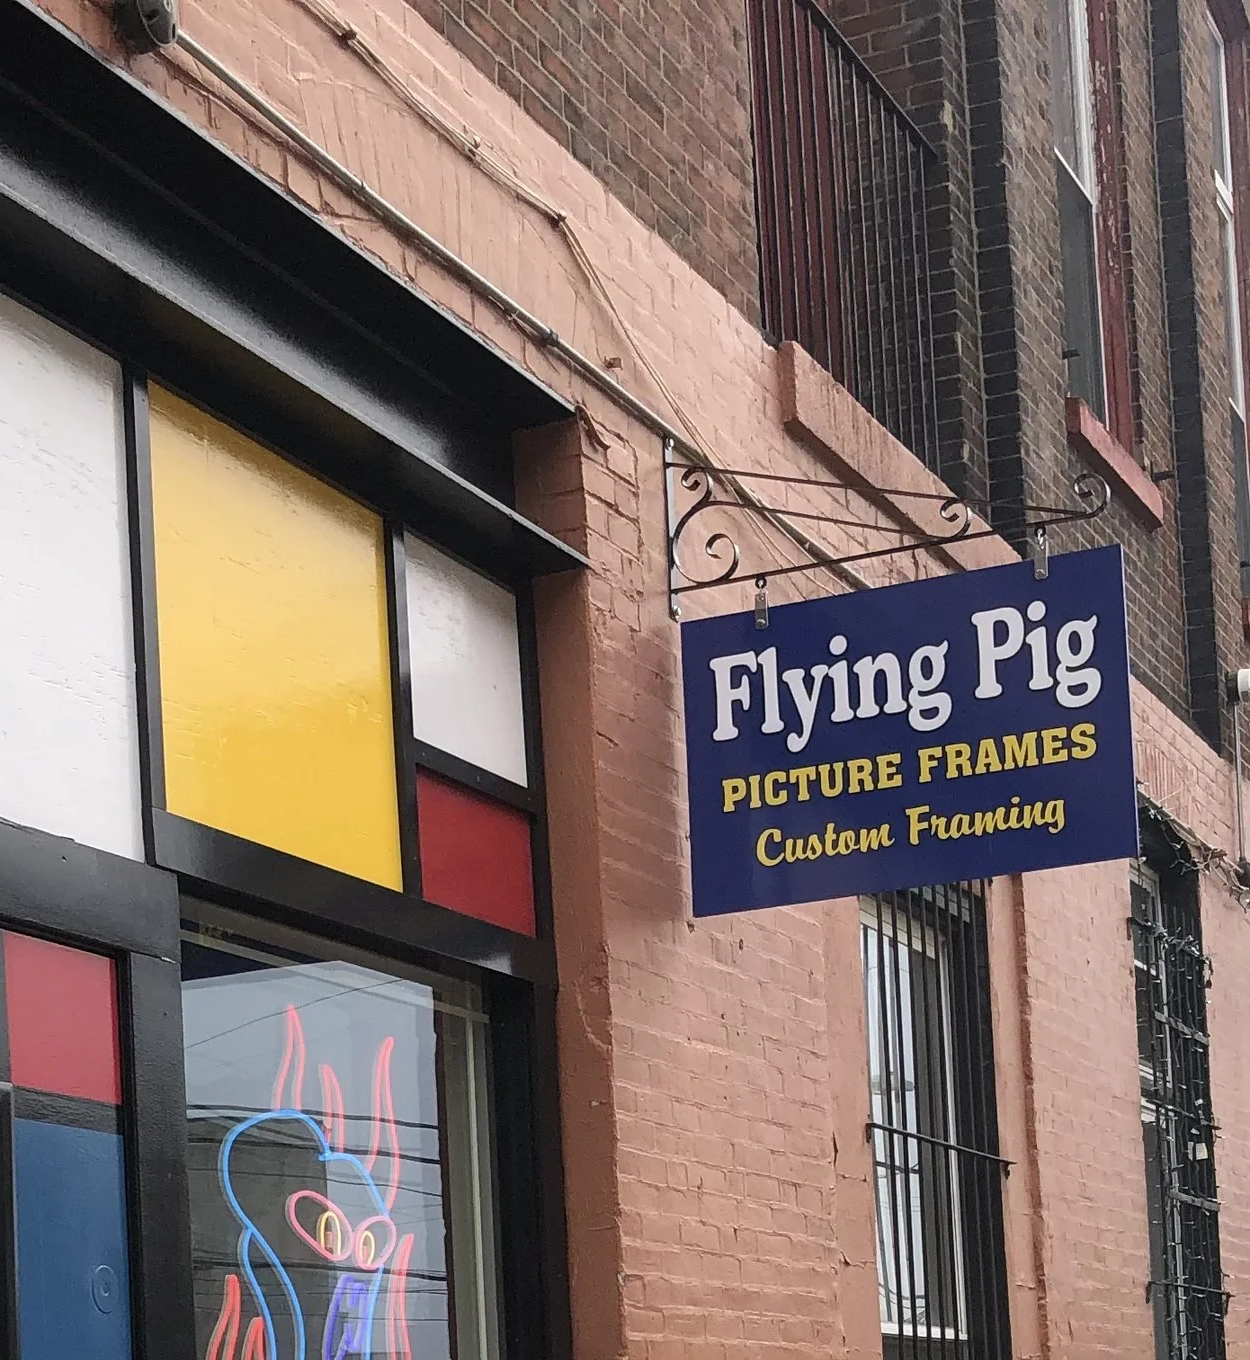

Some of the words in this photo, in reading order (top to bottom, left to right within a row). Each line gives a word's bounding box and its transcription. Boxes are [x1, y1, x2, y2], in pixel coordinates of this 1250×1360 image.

[709, 635, 952, 753] Flying
[971, 600, 1102, 708] Pig
[722, 752, 903, 813] PICTURE
[918, 723, 1098, 784] FRAMES
[755, 822, 894, 867] Custom
[905, 796, 1065, 847] Framing
